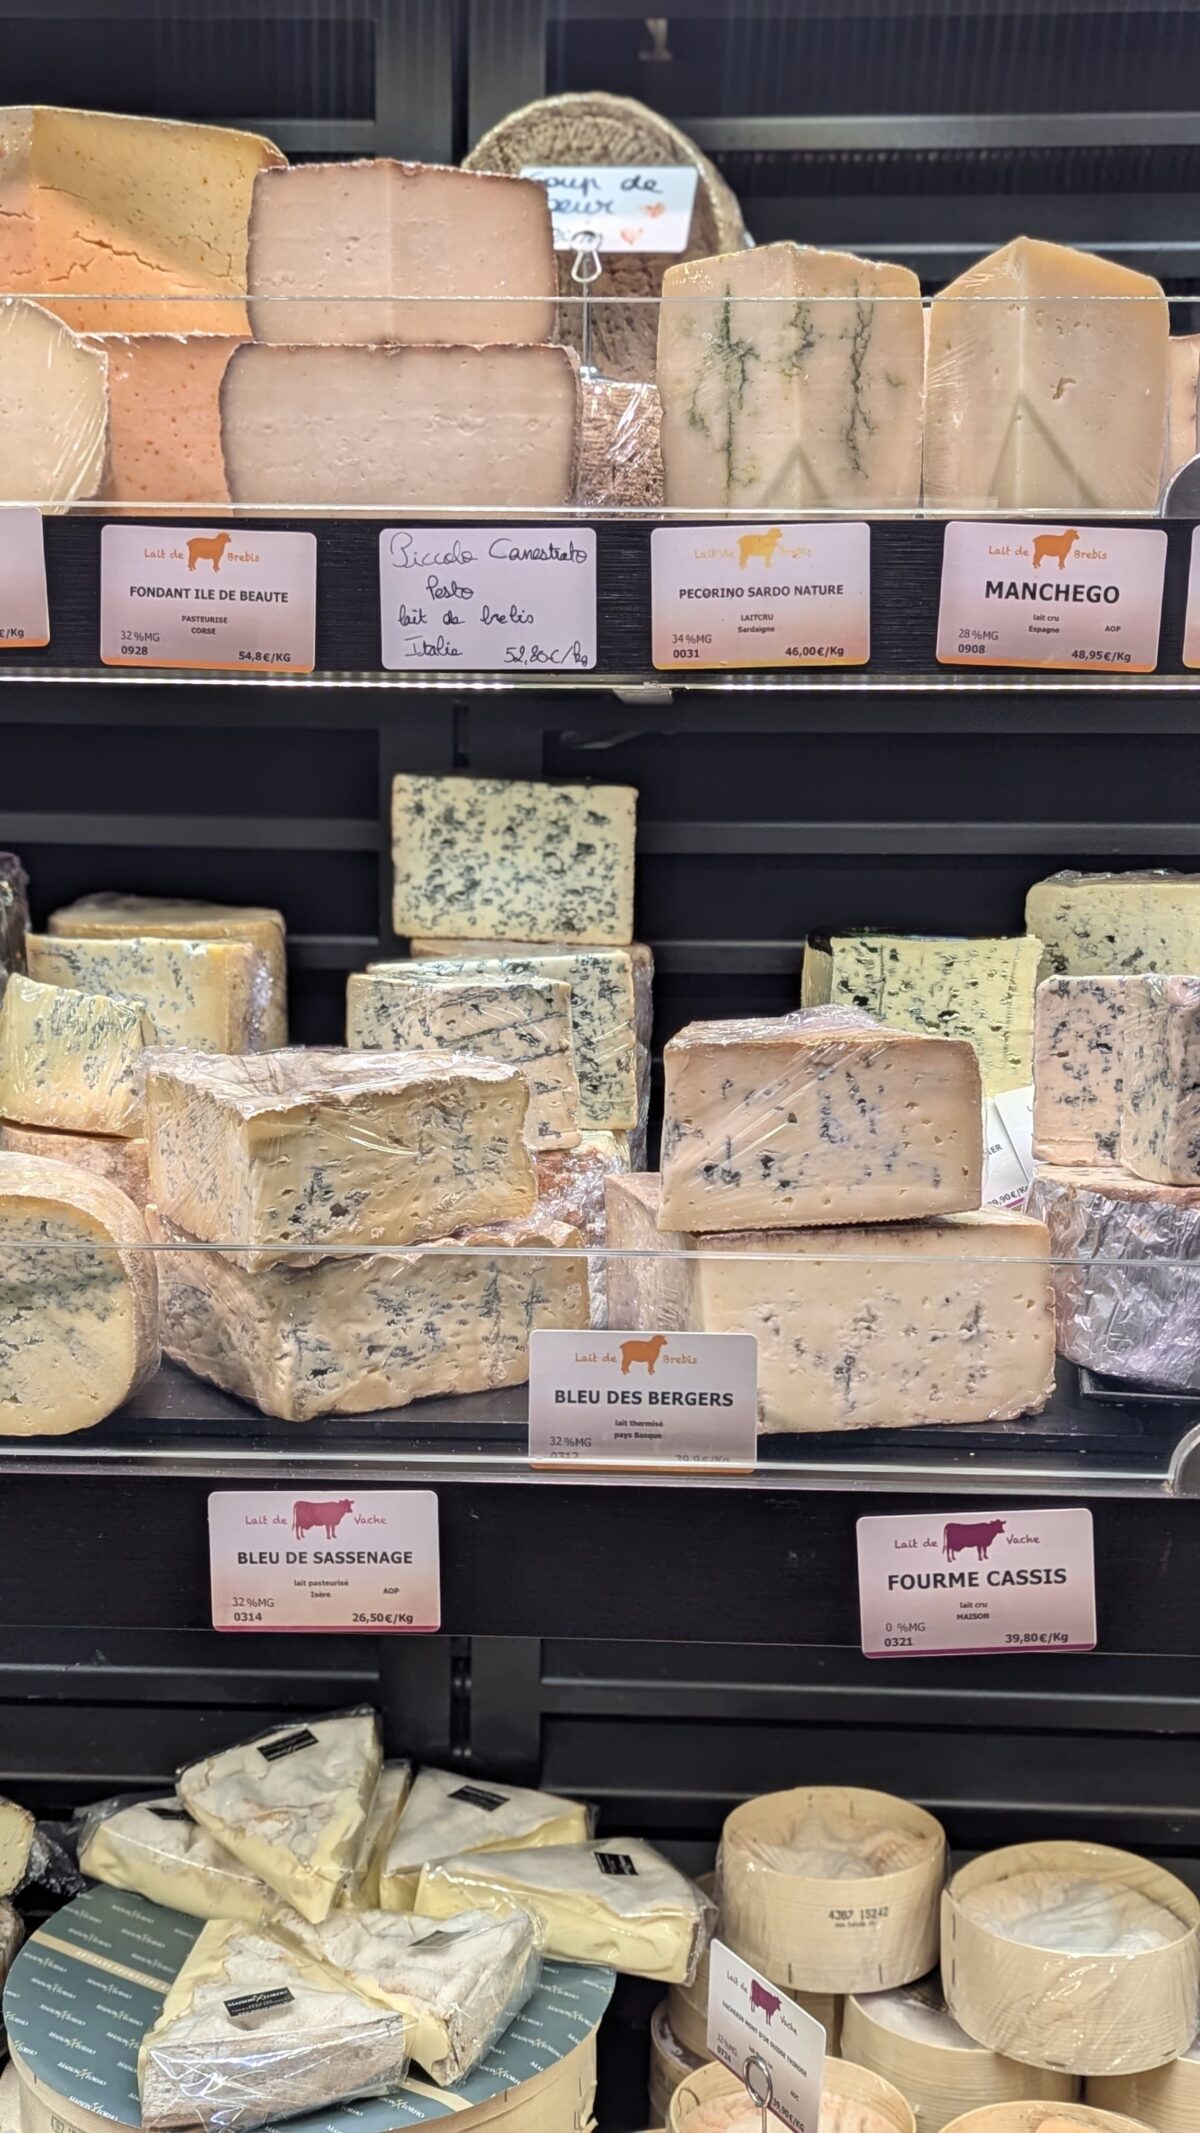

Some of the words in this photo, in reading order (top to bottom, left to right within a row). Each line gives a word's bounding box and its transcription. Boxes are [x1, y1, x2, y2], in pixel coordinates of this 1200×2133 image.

[620, 174, 663, 195] de
[144, 548, 166, 559] Lait
[170, 550, 184, 560] de
[227, 552, 260, 562] Brebis
[988, 545, 1011, 556] Lait
[1015, 547, 1029, 556] de
[1073, 549, 1108, 560] Brebis
[426, 575, 474, 600] Pesto
[679, 587, 744, 600] PECORINO
[747, 586, 790, 598] SARDO
[794, 584, 844, 596] NATURE
[985, 580, 1120, 604] MANCHEGO
[129, 586, 191, 599] FONDANT
[194, 588, 215, 600] ILE
[219, 589, 236, 601] DE
[239, 590, 289, 603] BEAUTE
[181, 615, 228, 624] PASTEURISE
[398, 604, 427, 625] lait
[1033, 613, 1046, 622] lait
[191, 627, 216, 635] CORSE
[737, 625, 775, 634] Sardaigne
[1028, 625, 1060, 634] Espagne
[121, 646, 148, 655] 0928
[673, 649, 700, 659] 0031
[957, 644, 986, 654] 0908
[575, 1352, 597, 1363] Lait
[602, 1353, 617, 1363] de
[663, 1354, 698, 1364] Brebis
[554, 1390, 600, 1404] BLEU
[607, 1390, 642, 1405] DES
[648, 1391, 734, 1407] BERGERS
[615, 1419, 628, 1427] lait
[629, 1419, 664, 1428] thermisé
[614, 1432, 632, 1440] pays
[634, 1432, 662, 1440] Basque
[245, 1515, 268, 1525] Lait
[272, 1516, 288, 1525] de
[354, 1515, 387, 1525] Vache
[894, 1539, 918, 1549] Lait
[923, 1538, 938, 1548] de
[1006, 1534, 1040, 1545] Vache
[237, 1551, 279, 1564] BLEU
[286, 1551, 308, 1564] DE
[313, 1551, 413, 1564] SASSENAGE
[294, 1579, 307, 1587] lait
[308, 1579, 349, 1588] pasteurisé
[888, 1571, 980, 1591] FOURME
[986, 1568, 1067, 1586] CASSIS
[310, 1590, 331, 1598] Isère
[233, 1612, 262, 1622] 0314
[884, 1637, 913, 1647] 0321
